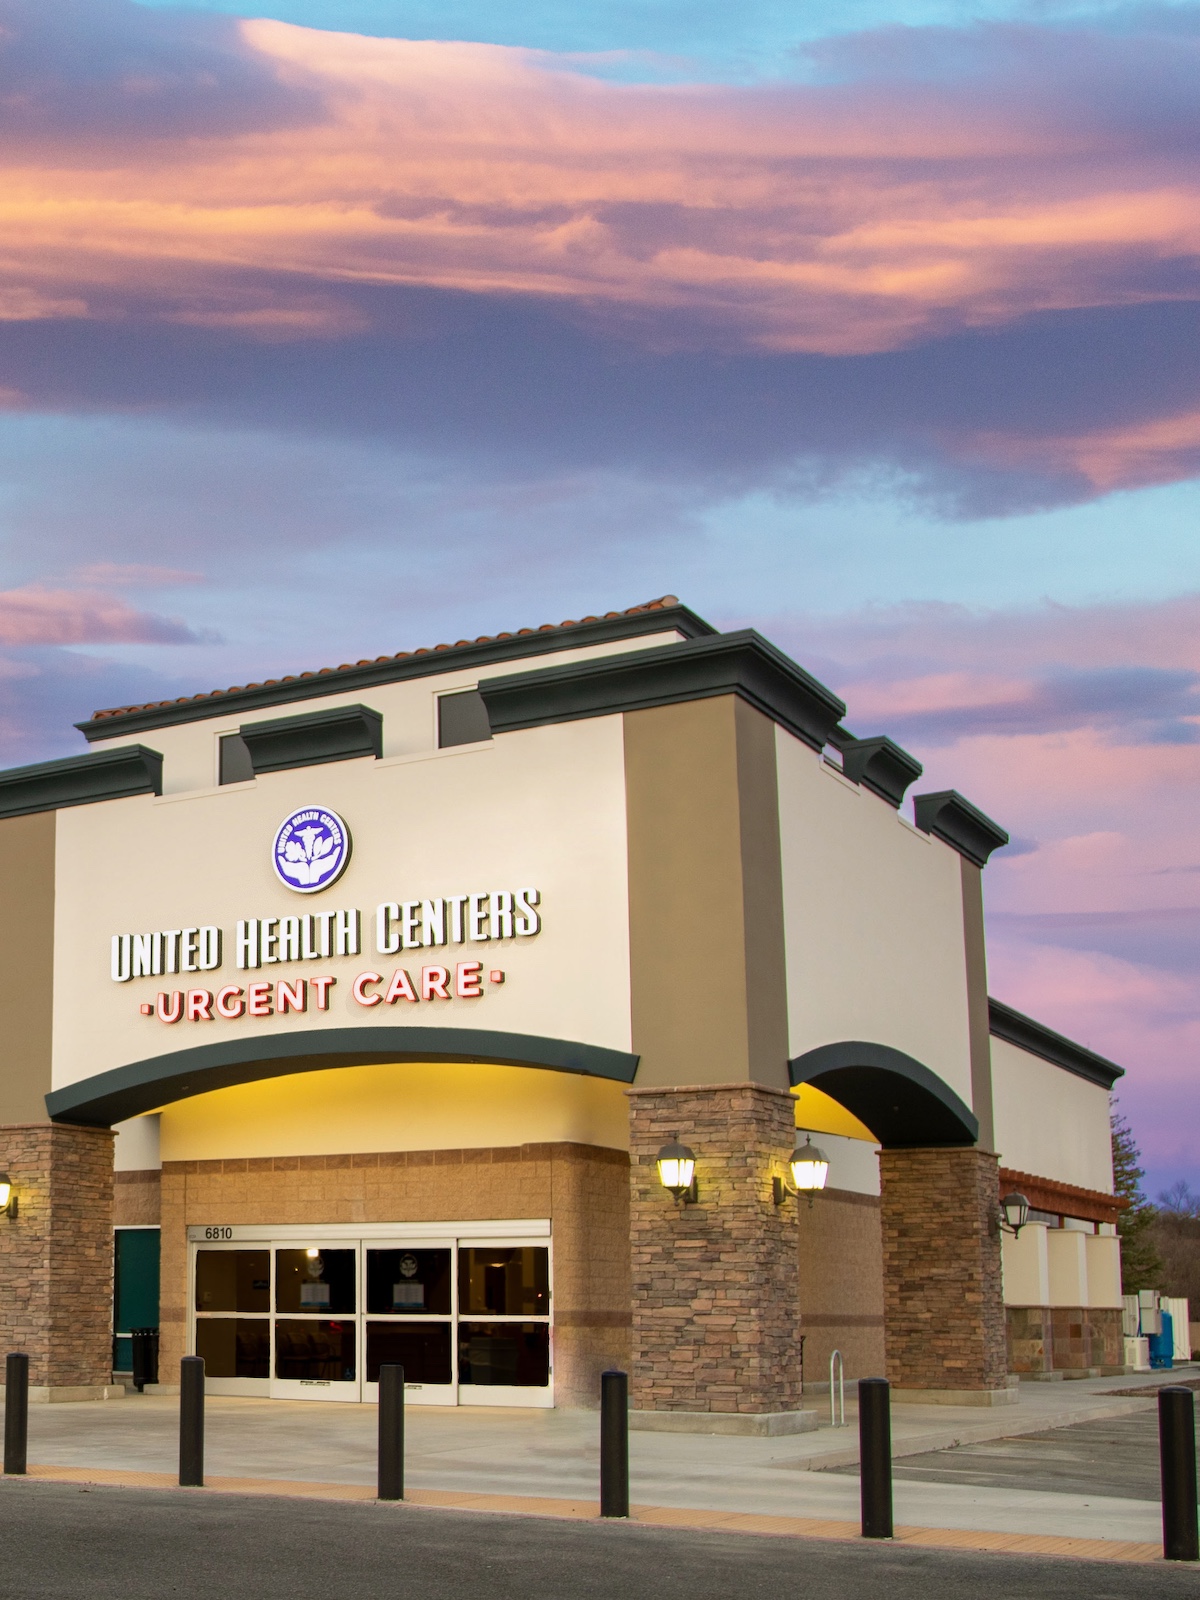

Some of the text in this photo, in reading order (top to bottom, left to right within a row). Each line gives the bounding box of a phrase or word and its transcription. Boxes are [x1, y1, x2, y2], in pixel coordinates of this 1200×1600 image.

[292, 811, 319, 827] HEALTH
[111, 887, 540, 982] UNITED HEALTH CENTERS
[205, 1227, 233, 1240] 6810
